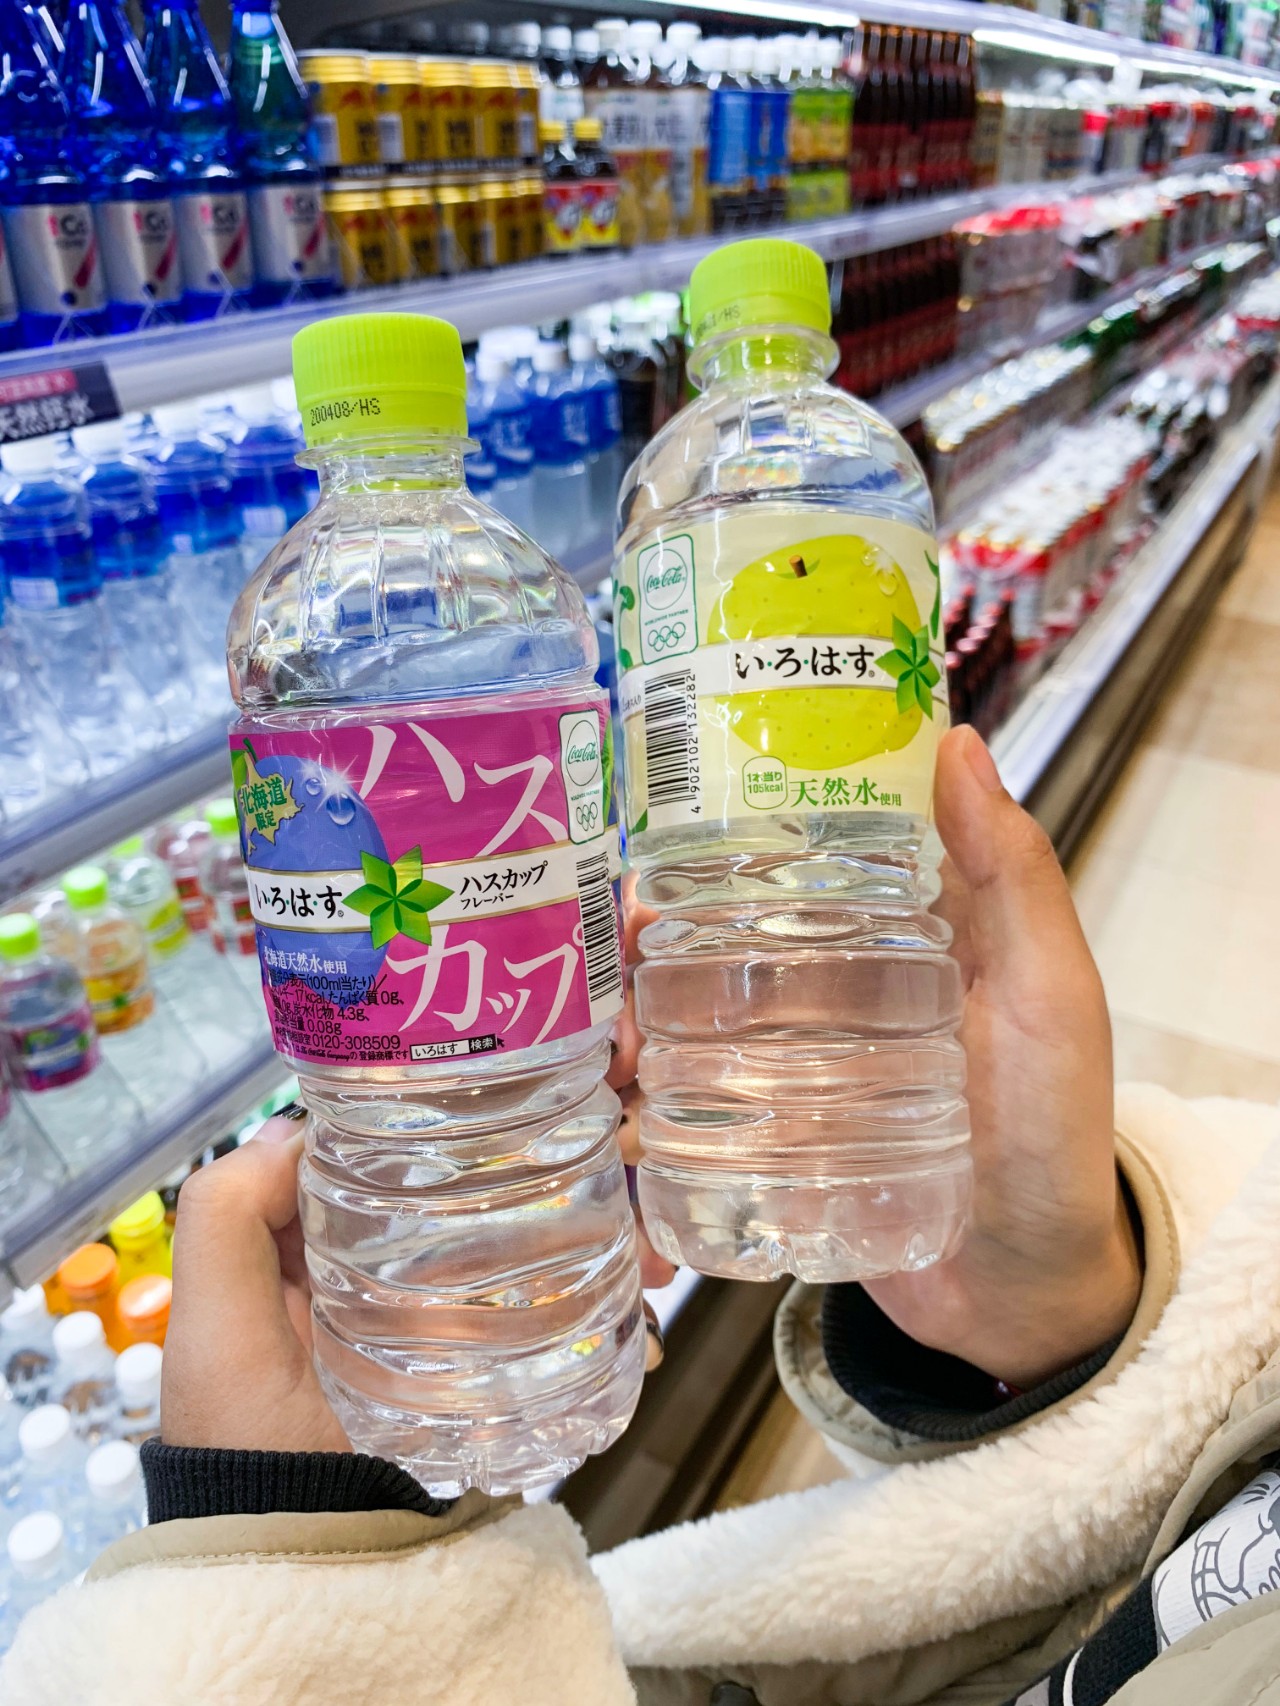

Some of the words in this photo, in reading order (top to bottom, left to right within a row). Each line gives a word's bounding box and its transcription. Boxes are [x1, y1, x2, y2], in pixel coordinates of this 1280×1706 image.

[311, 398, 381, 426] 200408/HS
[241, 776, 287, 816] 北海道
[748, 784, 784, 794] 105kcal
[255, 811, 277, 831] 限定
[460, 860, 549, 895] ハスカップ
[461, 893, 515, 910] フレーバー
[312, 1033, 401, 1050] 0120-308509
[415, 1043, 458, 1057] いろはす
[470, 1037, 494, 1051] 検索
